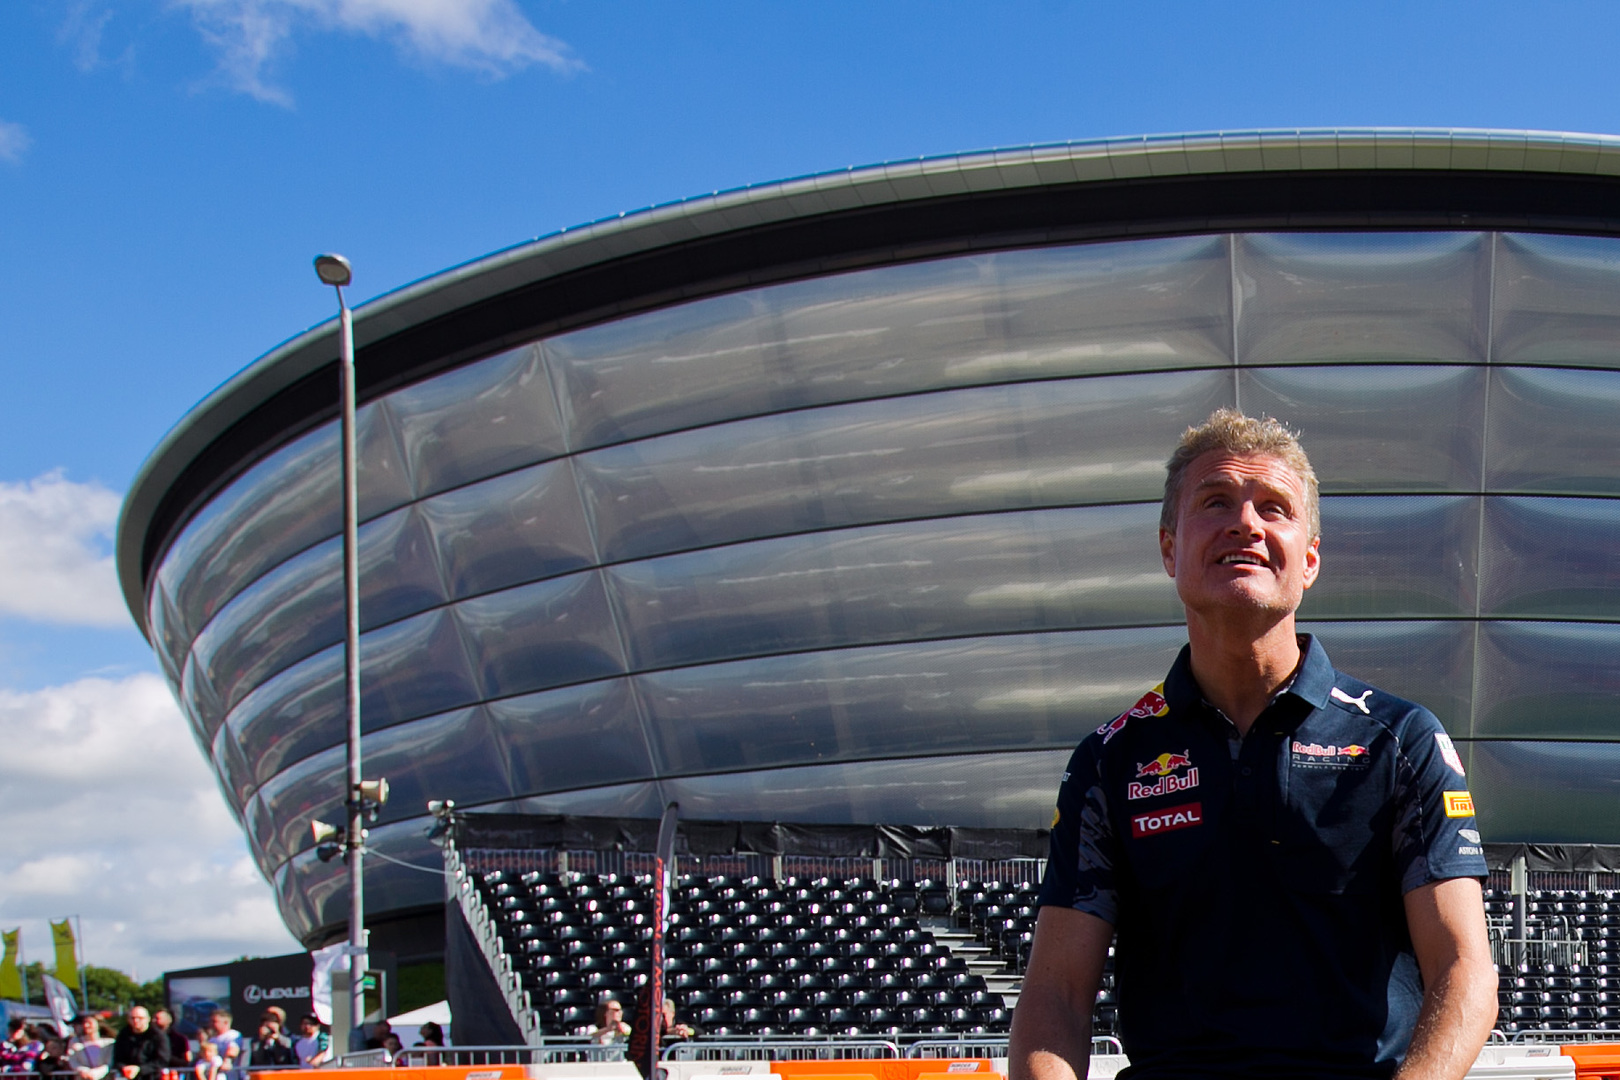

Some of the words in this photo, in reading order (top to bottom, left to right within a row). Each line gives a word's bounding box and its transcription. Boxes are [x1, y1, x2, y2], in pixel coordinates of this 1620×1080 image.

[1292, 754, 1371, 764] RACING
[1128, 777, 1165, 800] Red
[1165, 767, 1200, 794] Bull
[1134, 809, 1201, 832] TOTAL
[261, 985, 310, 1000] LEXUS
